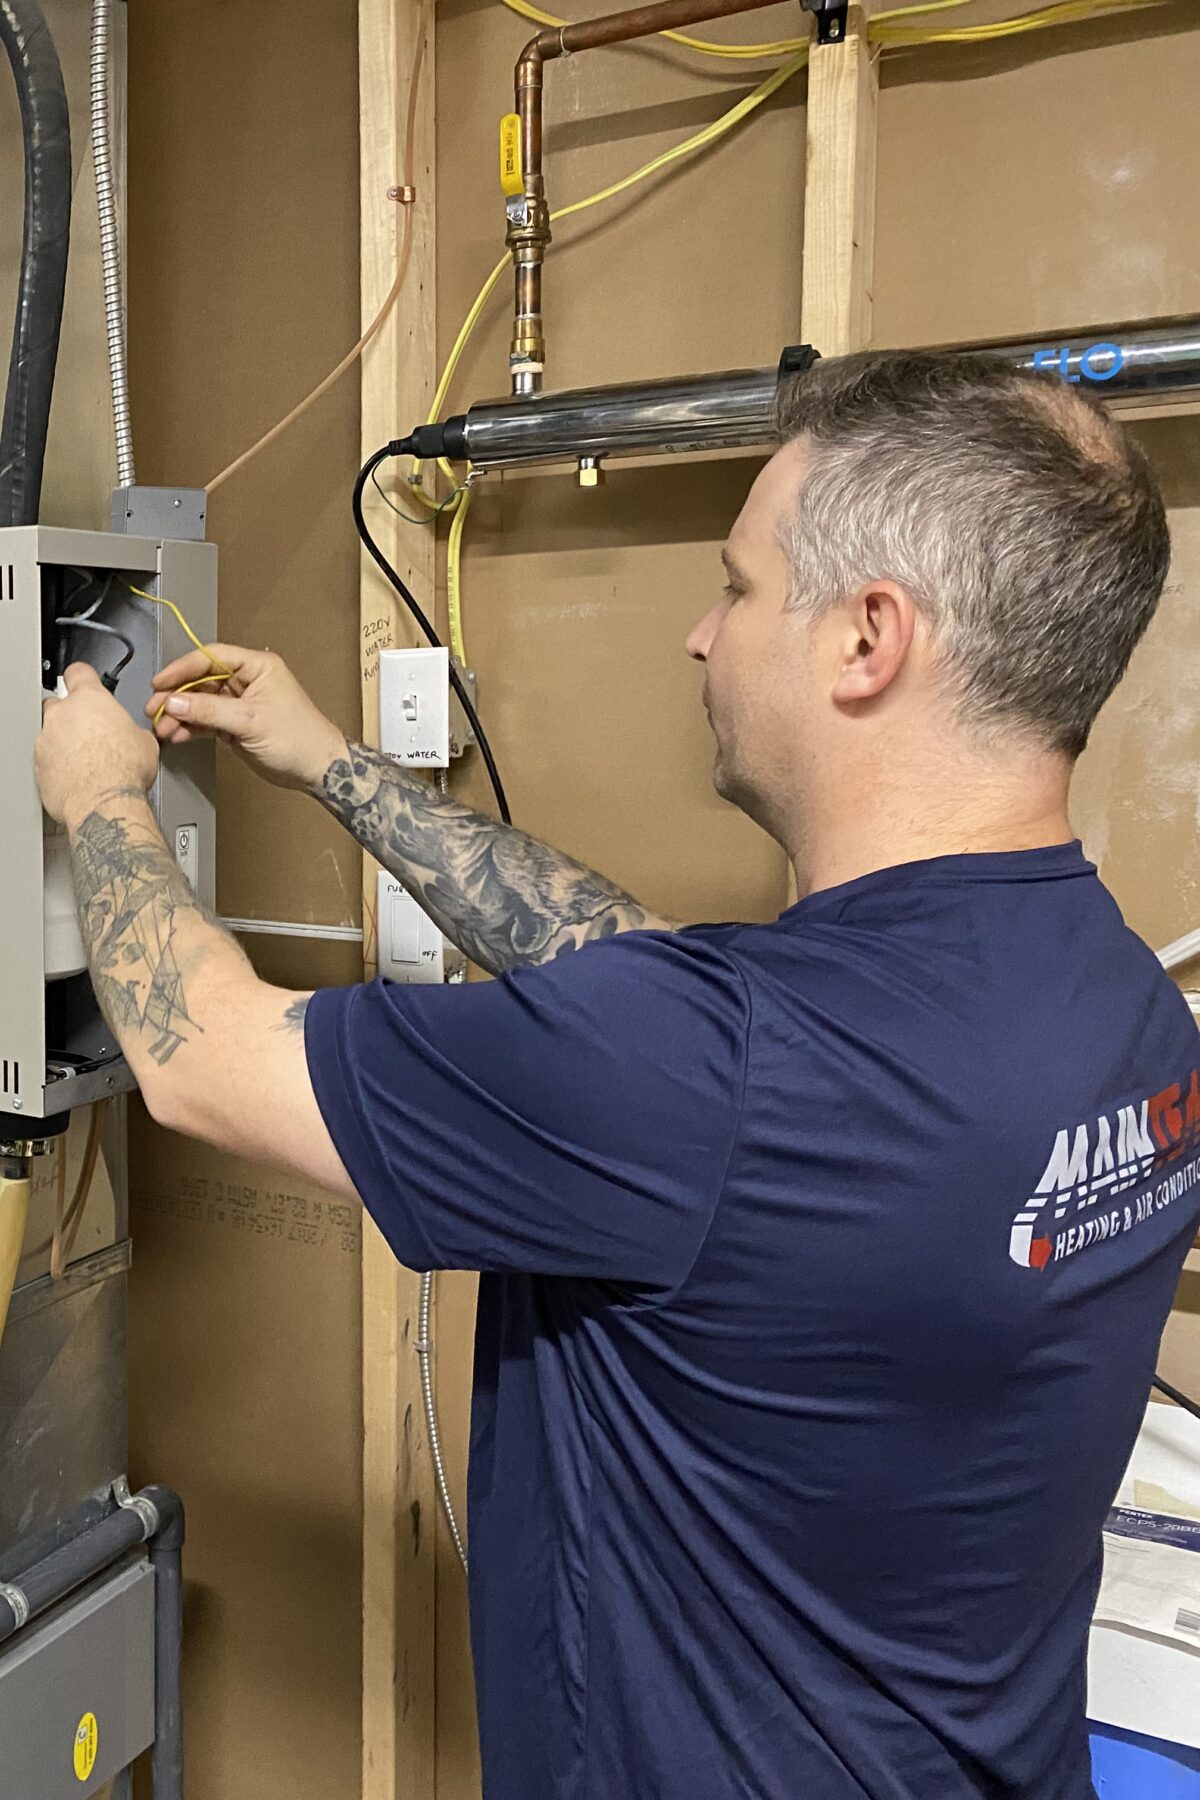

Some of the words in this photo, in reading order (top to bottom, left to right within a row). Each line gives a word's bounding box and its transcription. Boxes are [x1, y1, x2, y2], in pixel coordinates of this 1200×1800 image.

[366, 632, 394, 657] WATER
[407, 751, 442, 760] WATER
[387, 885, 405, 893] FUR
[1054, 1211, 1121, 1261] HEATING
[1123, 1206, 1133, 1231] &
[1135, 1191, 1153, 1224] AIR
[1119, 1509, 1153, 1519] PENTEK
